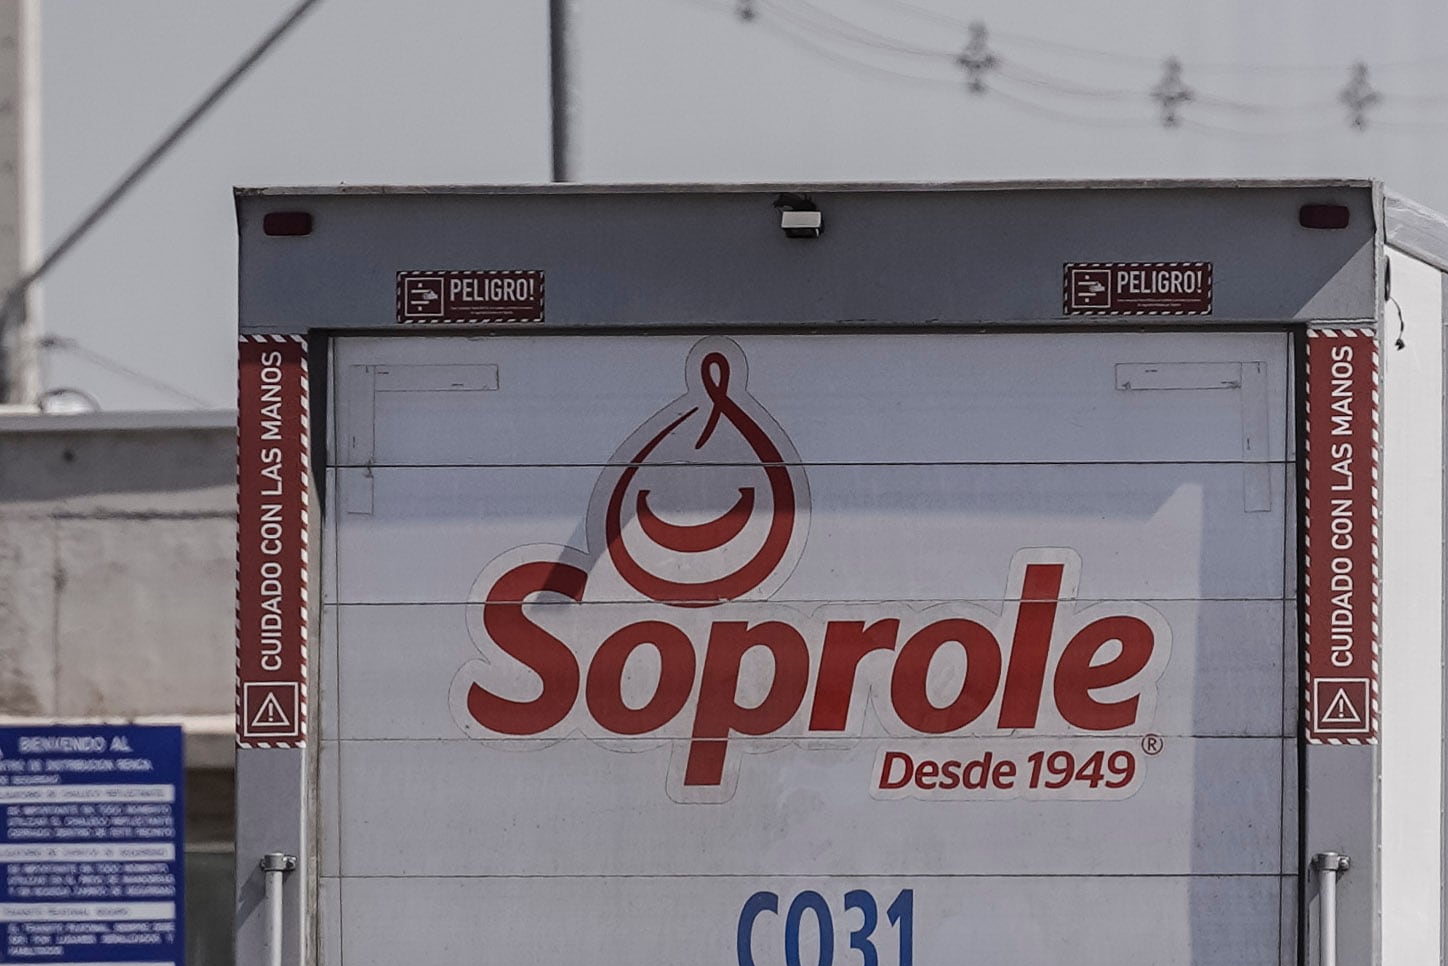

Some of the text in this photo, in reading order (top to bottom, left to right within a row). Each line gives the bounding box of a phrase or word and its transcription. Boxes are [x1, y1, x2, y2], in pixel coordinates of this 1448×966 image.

[450, 278, 534, 301] PELIGRO!
[1117, 270, 1202, 294] PELIGRO!
[260, 351, 282, 672] CUIDADO CON LAS MANOS
[1330, 345, 1353, 667] CUIDADO CON LAS MANOS
[467, 562, 1154, 787] Soprole
[879, 751, 1137, 790] Desde 1949
